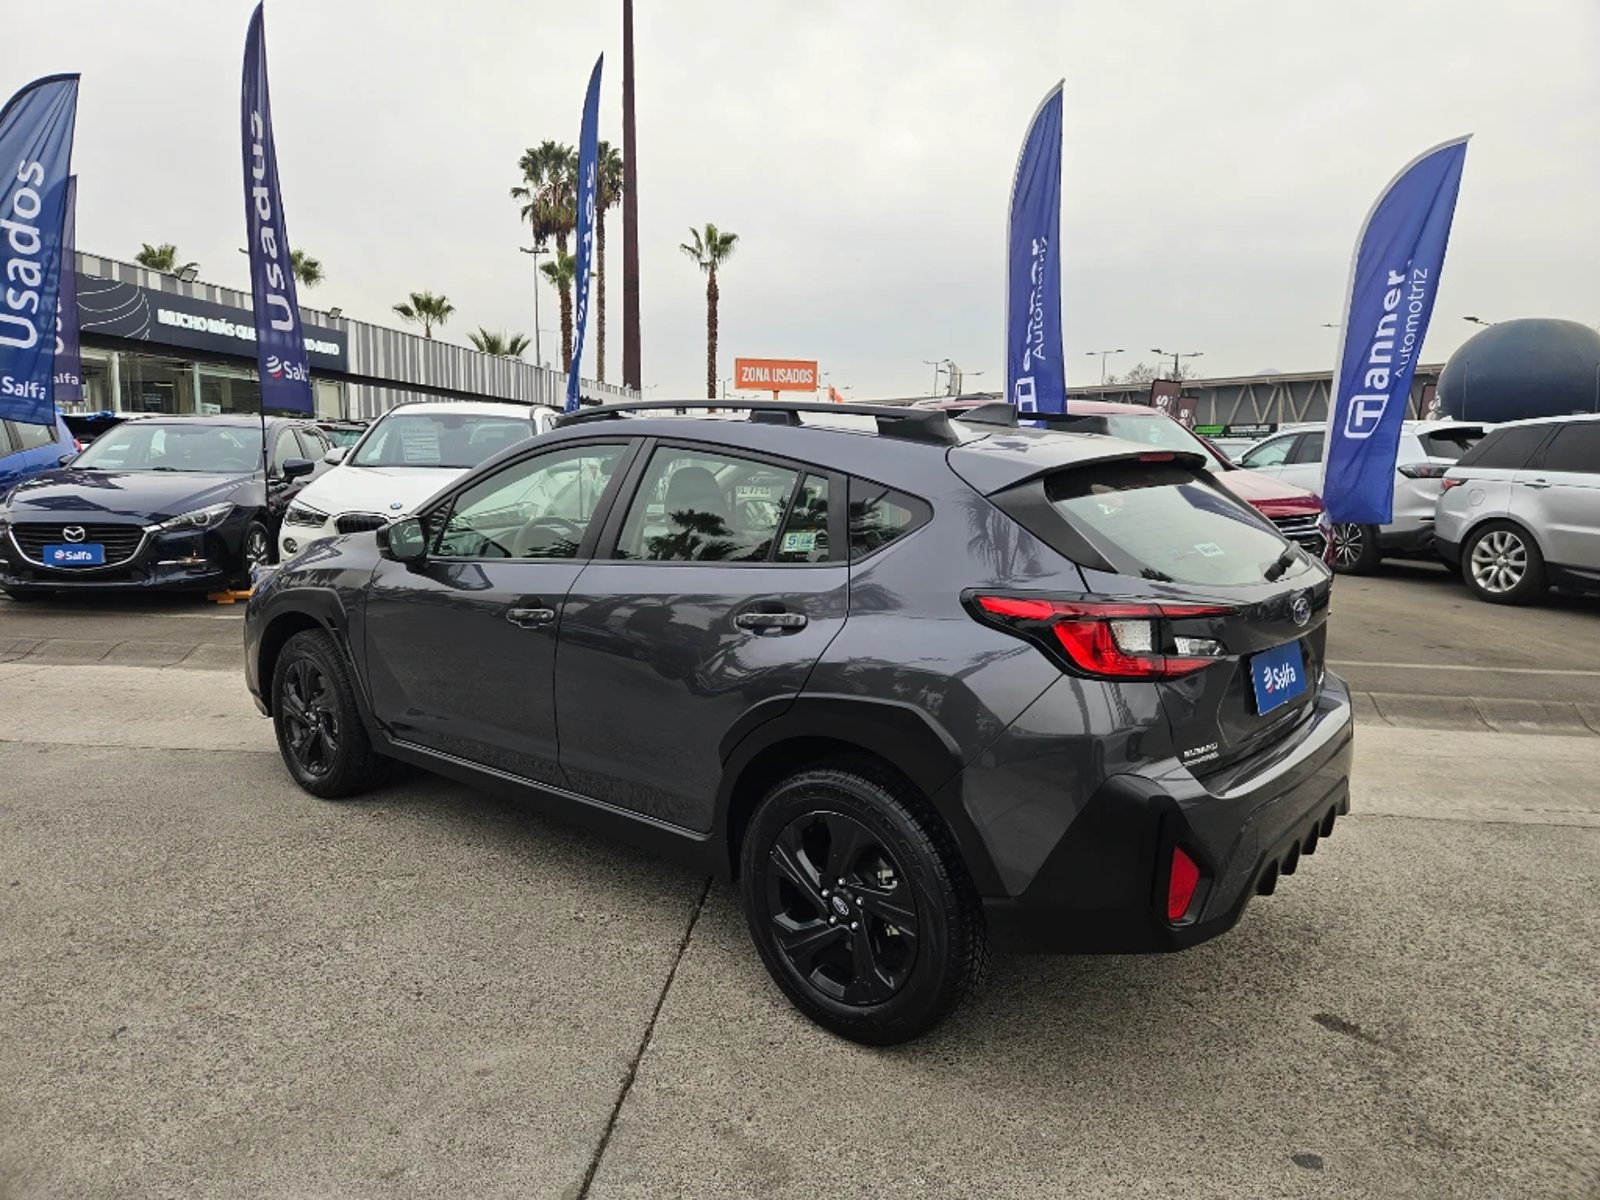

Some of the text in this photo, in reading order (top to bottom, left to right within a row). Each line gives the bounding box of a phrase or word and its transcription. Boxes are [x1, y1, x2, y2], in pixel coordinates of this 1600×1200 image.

[0, 158, 46, 349] Usados
[157, 309, 207, 332] MUCHO
[1395, 268, 1428, 378] Automotriz
[53, 373, 79, 385] alfa
[741, 366, 813, 384] ZONA USADOS
[65, 551, 92, 560] Salfa
